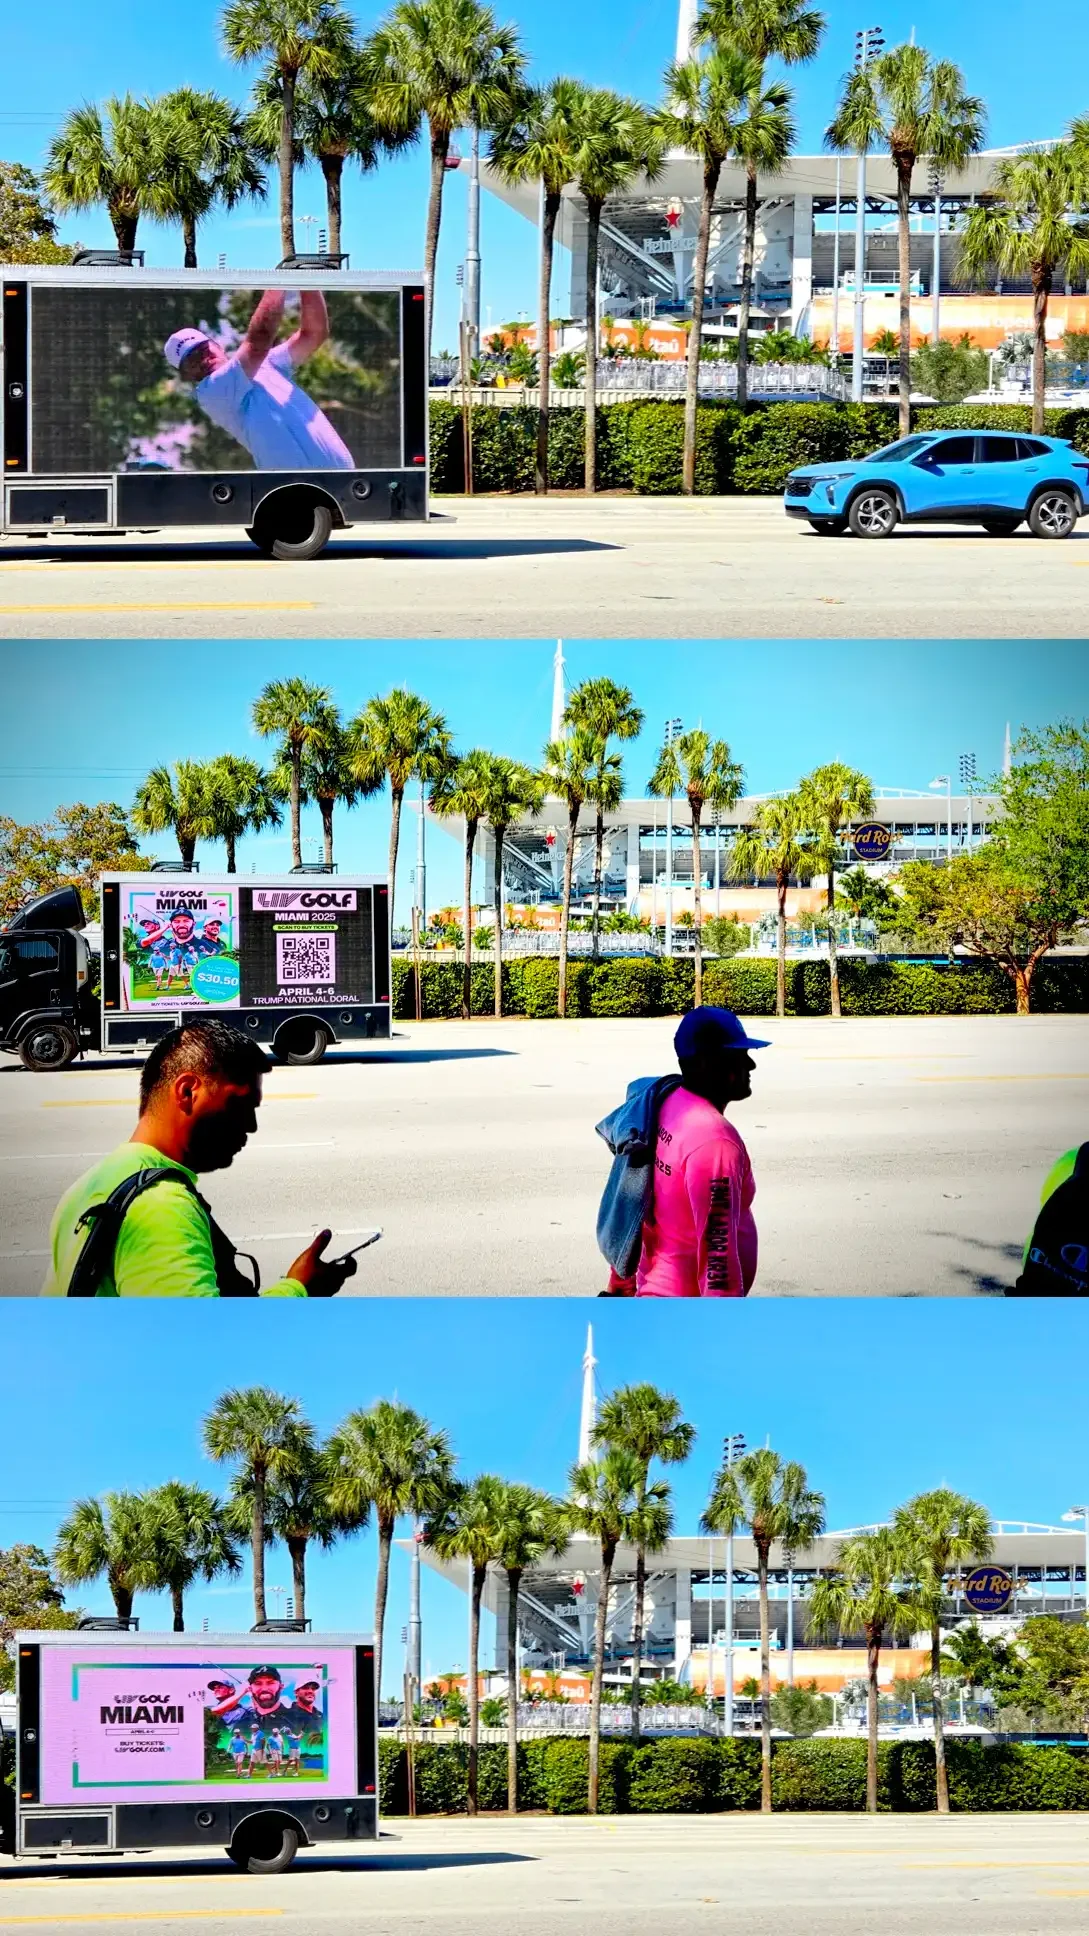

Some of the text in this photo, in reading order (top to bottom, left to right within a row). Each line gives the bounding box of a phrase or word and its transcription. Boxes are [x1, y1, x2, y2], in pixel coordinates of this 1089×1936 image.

[644, 237, 698, 252] Heineke
[840, 830, 872, 843] Hard
[532, 851, 565, 862] Heineke
[156, 898, 208, 910] MIAMI
[300, 892, 352, 908] GOLF
[274, 912, 336, 921] MIAMI 2025
[197, 972, 239, 986] $30.50
[278, 987, 335, 996] APRIL 4-6
[252, 994, 360, 1005] TRUMP NATIONAL DORAL
[946, 1575, 988, 1592] Hard
[554, 1603, 597, 1616] Heineke
[100, 1706, 184, 1724] MIAMI
